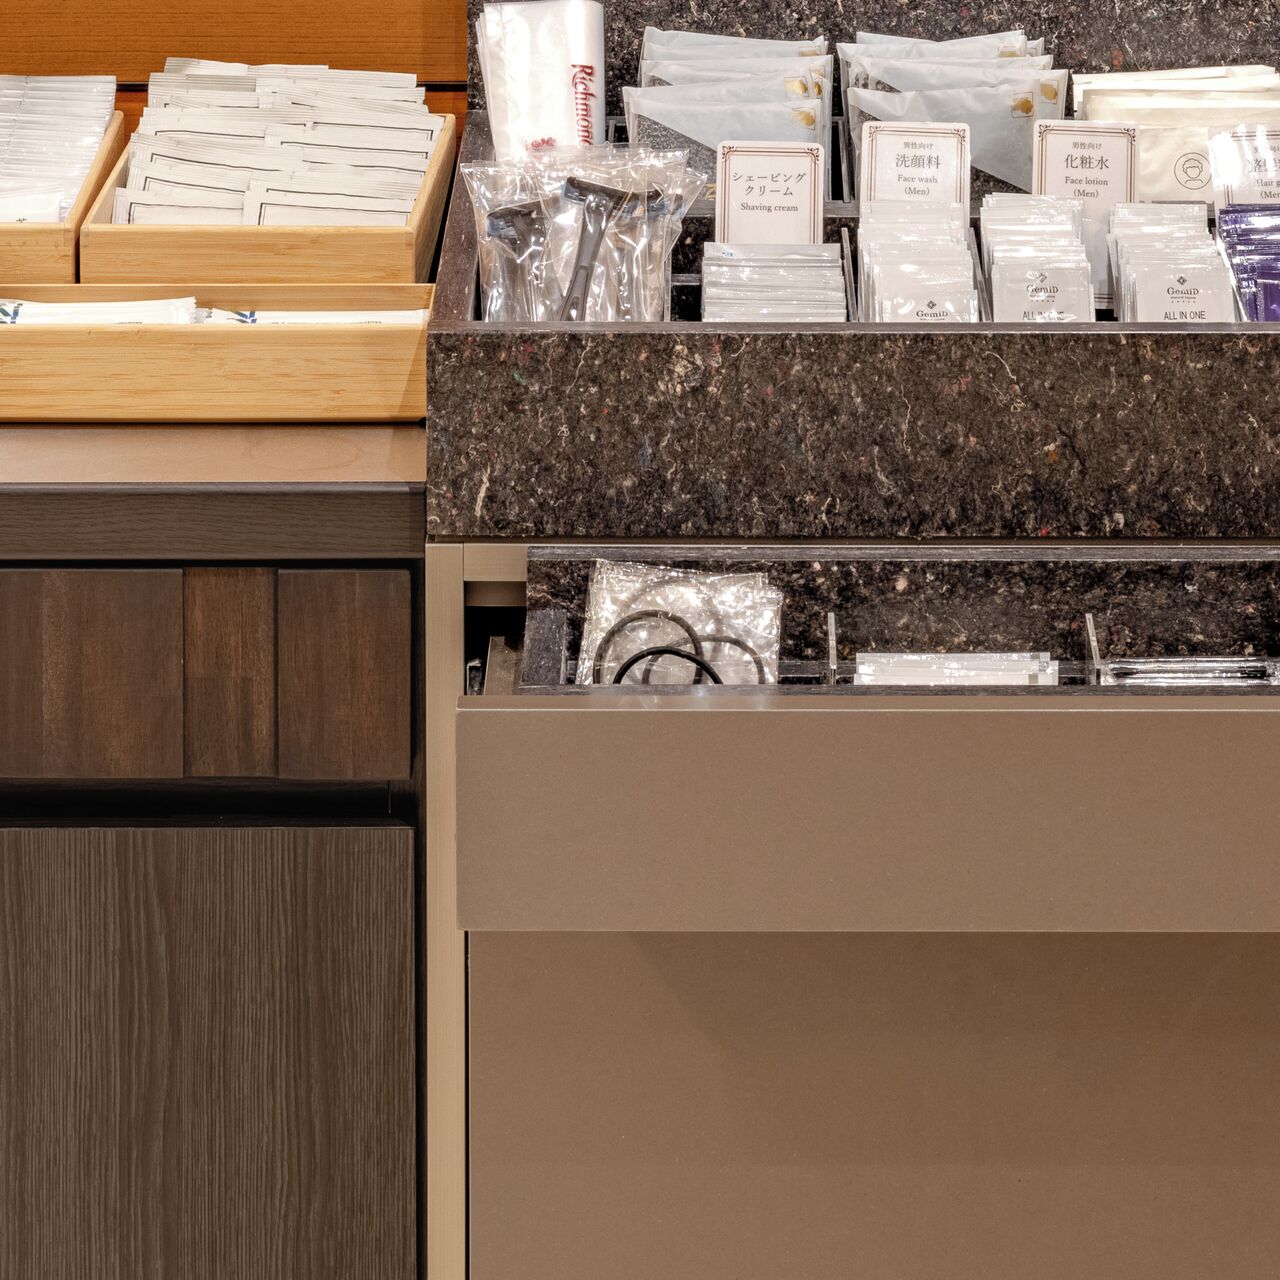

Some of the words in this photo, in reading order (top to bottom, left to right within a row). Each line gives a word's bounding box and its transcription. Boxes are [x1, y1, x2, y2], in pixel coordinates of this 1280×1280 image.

[903, 142, 933, 150] 男性向け
[1073, 141, 1102, 150] 男性向け
[895, 153, 941, 169] 洗顔料
[1064, 154, 1110, 170] 化粧水
[732, 172, 806, 183] シェービング
[897, 174, 916, 182] Face
[917, 175, 938, 183] wash
[1065, 176, 1083, 184] Face
[1085, 177, 1109, 186] lotion
[1256, 178, 1274, 187] Hair
[745, 185, 793, 196] クリーム
[904, 186, 930, 196] (Men)
[1073, 189, 1099, 198] (Men)
[740, 202, 772, 213] Shaving
[774, 204, 799, 212] cream
[1163, 312, 1177, 321] ALL
[1179, 311, 1187, 320] IN
[1189, 311, 1206, 320] ONE
